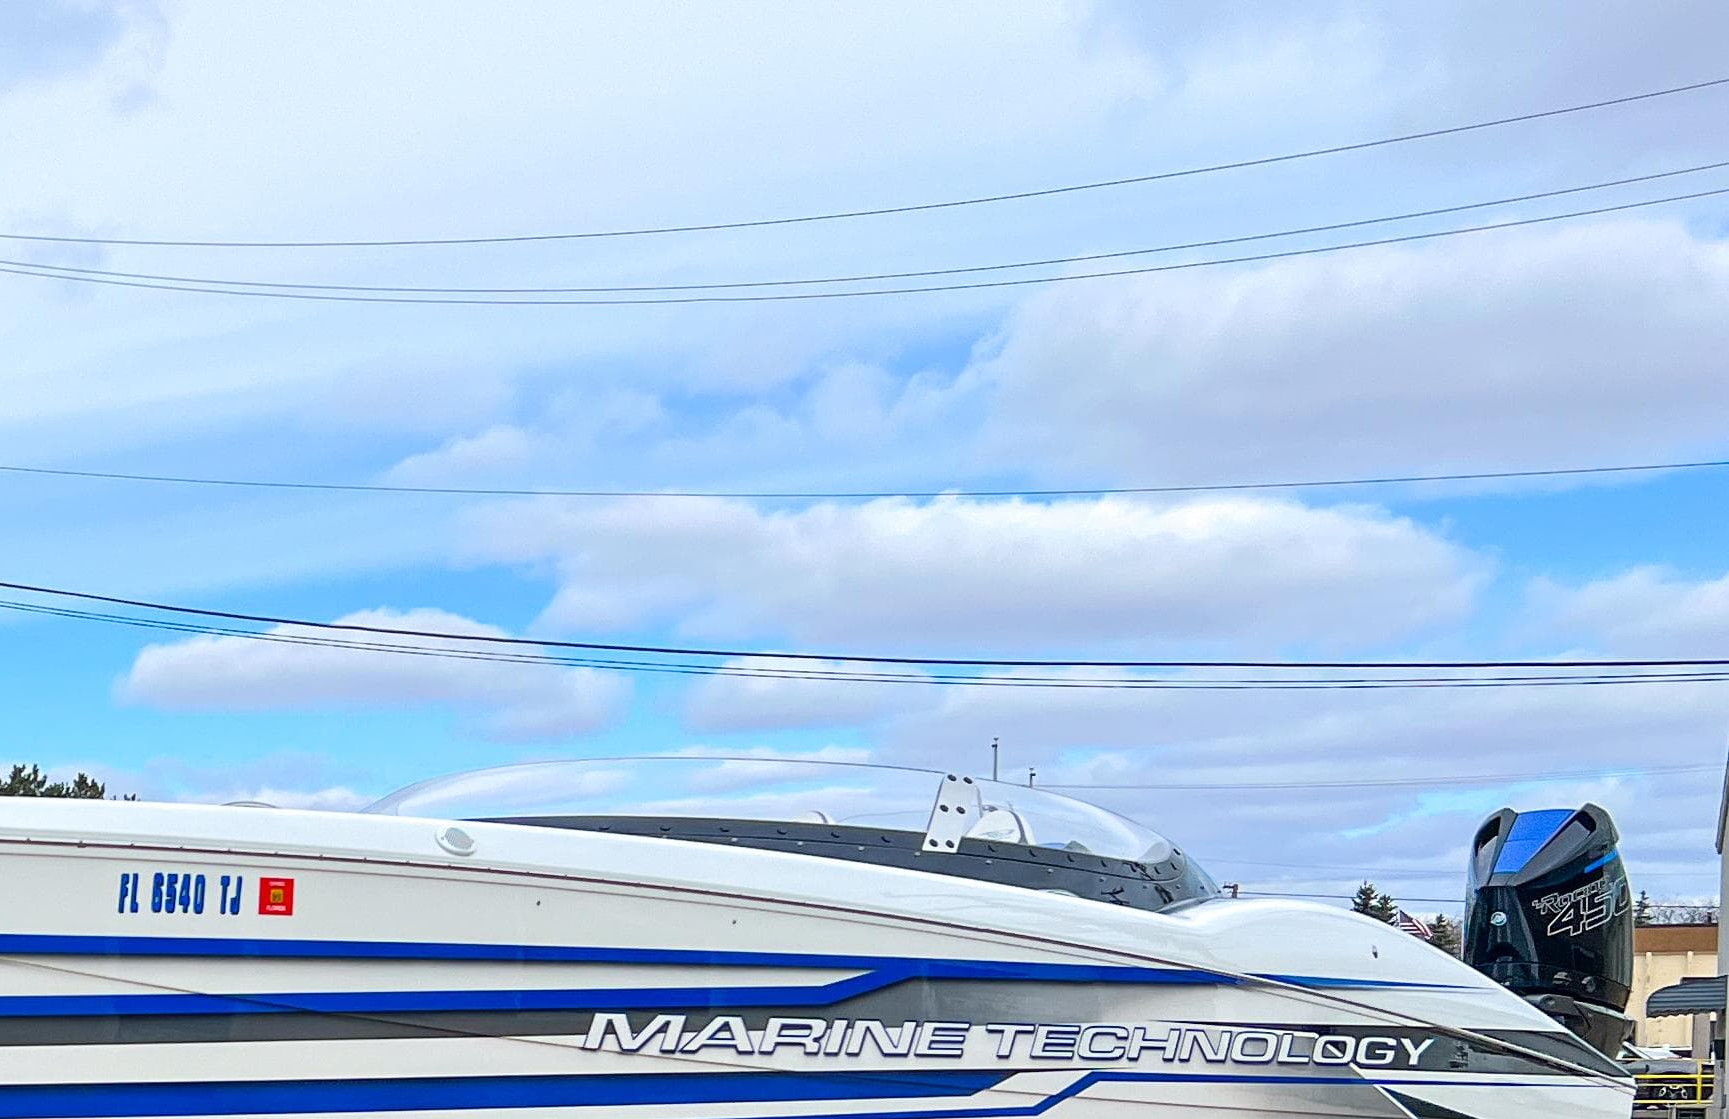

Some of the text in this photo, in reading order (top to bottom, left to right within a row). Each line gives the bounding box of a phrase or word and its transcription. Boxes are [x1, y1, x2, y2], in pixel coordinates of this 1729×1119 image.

[118, 872, 243, 916] FL 6540 TJ
[1547, 875, 1631, 936] 450
[583, 1013, 1435, 1067] MARINE TECHNOLOGY
